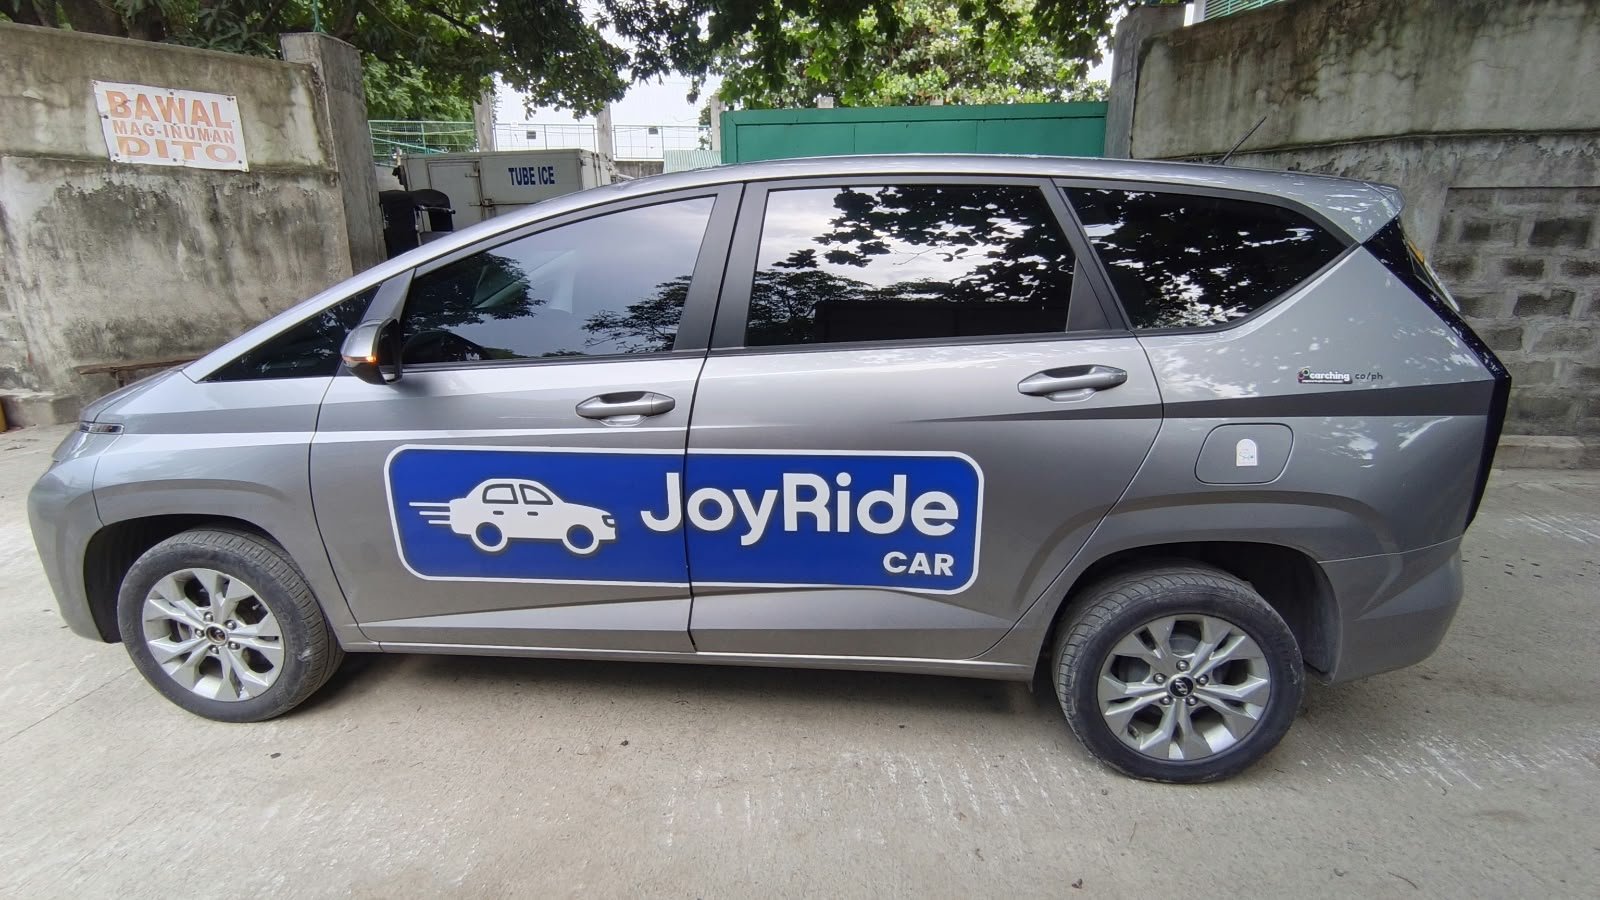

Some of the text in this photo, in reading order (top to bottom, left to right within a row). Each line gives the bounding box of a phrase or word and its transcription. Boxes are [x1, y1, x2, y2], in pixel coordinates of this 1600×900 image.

[106, 90, 232, 128] BAWAL
[113, 120, 235, 144] MAG-INUMAN
[116, 136, 237, 162] DITO
[508, 166, 555, 186] TUBE ICE
[1309, 371, 1350, 382] carching
[640, 472, 959, 545] JoyRide
[883, 551, 954, 576] CAR
